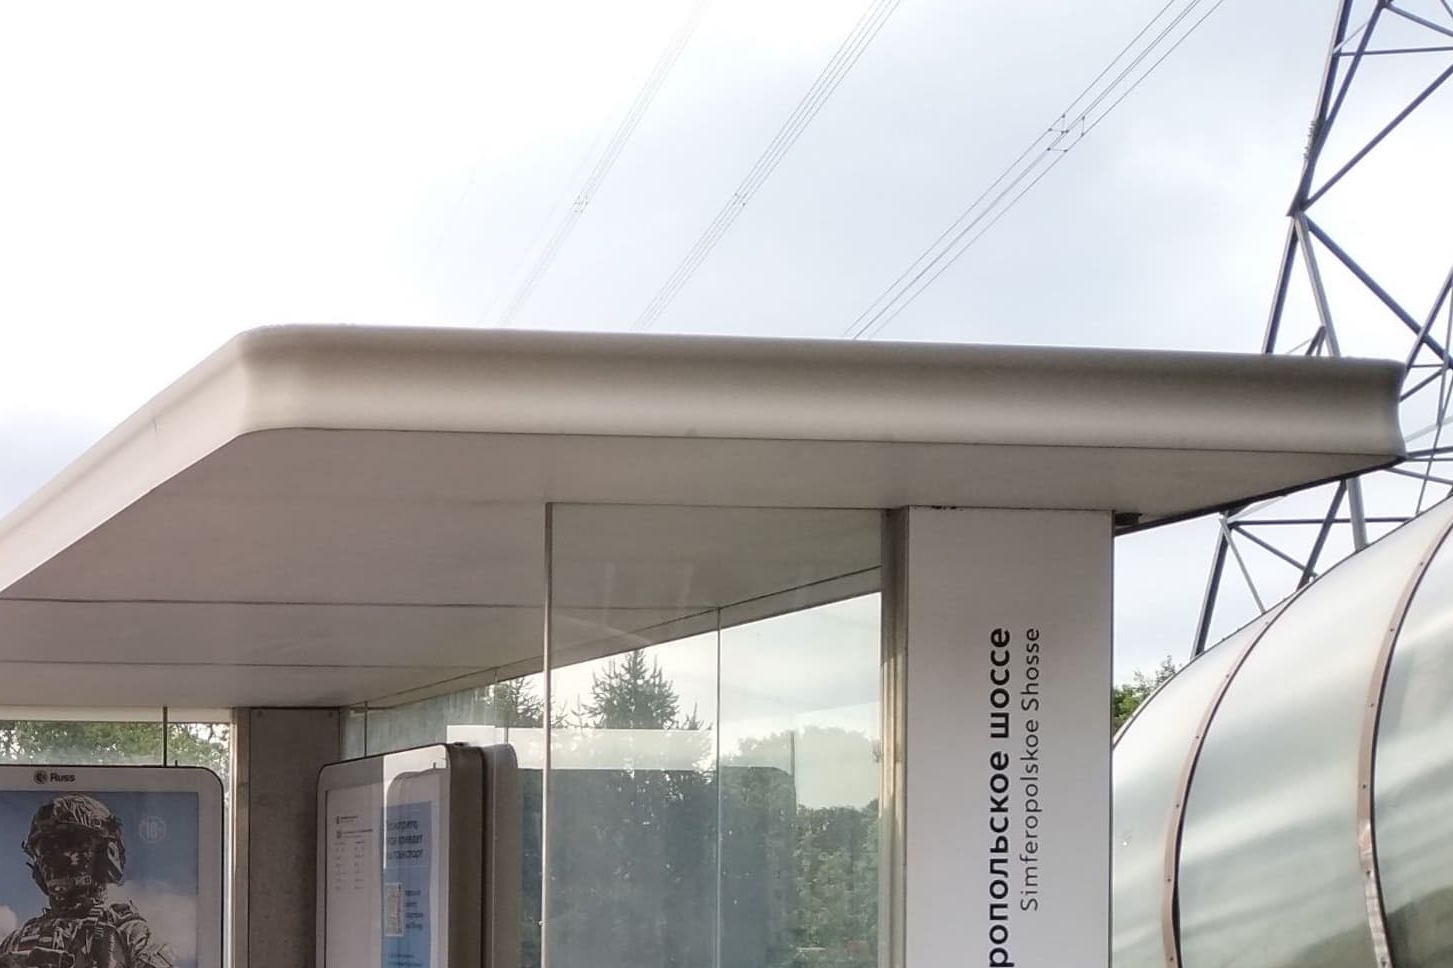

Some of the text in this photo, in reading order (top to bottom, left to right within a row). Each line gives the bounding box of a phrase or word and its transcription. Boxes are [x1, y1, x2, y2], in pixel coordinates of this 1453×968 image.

[988, 627, 1011, 740] шоссе
[50, 773, 76, 782] Russ
[1020, 627, 1043, 912] Simferopolskoe Shosse
